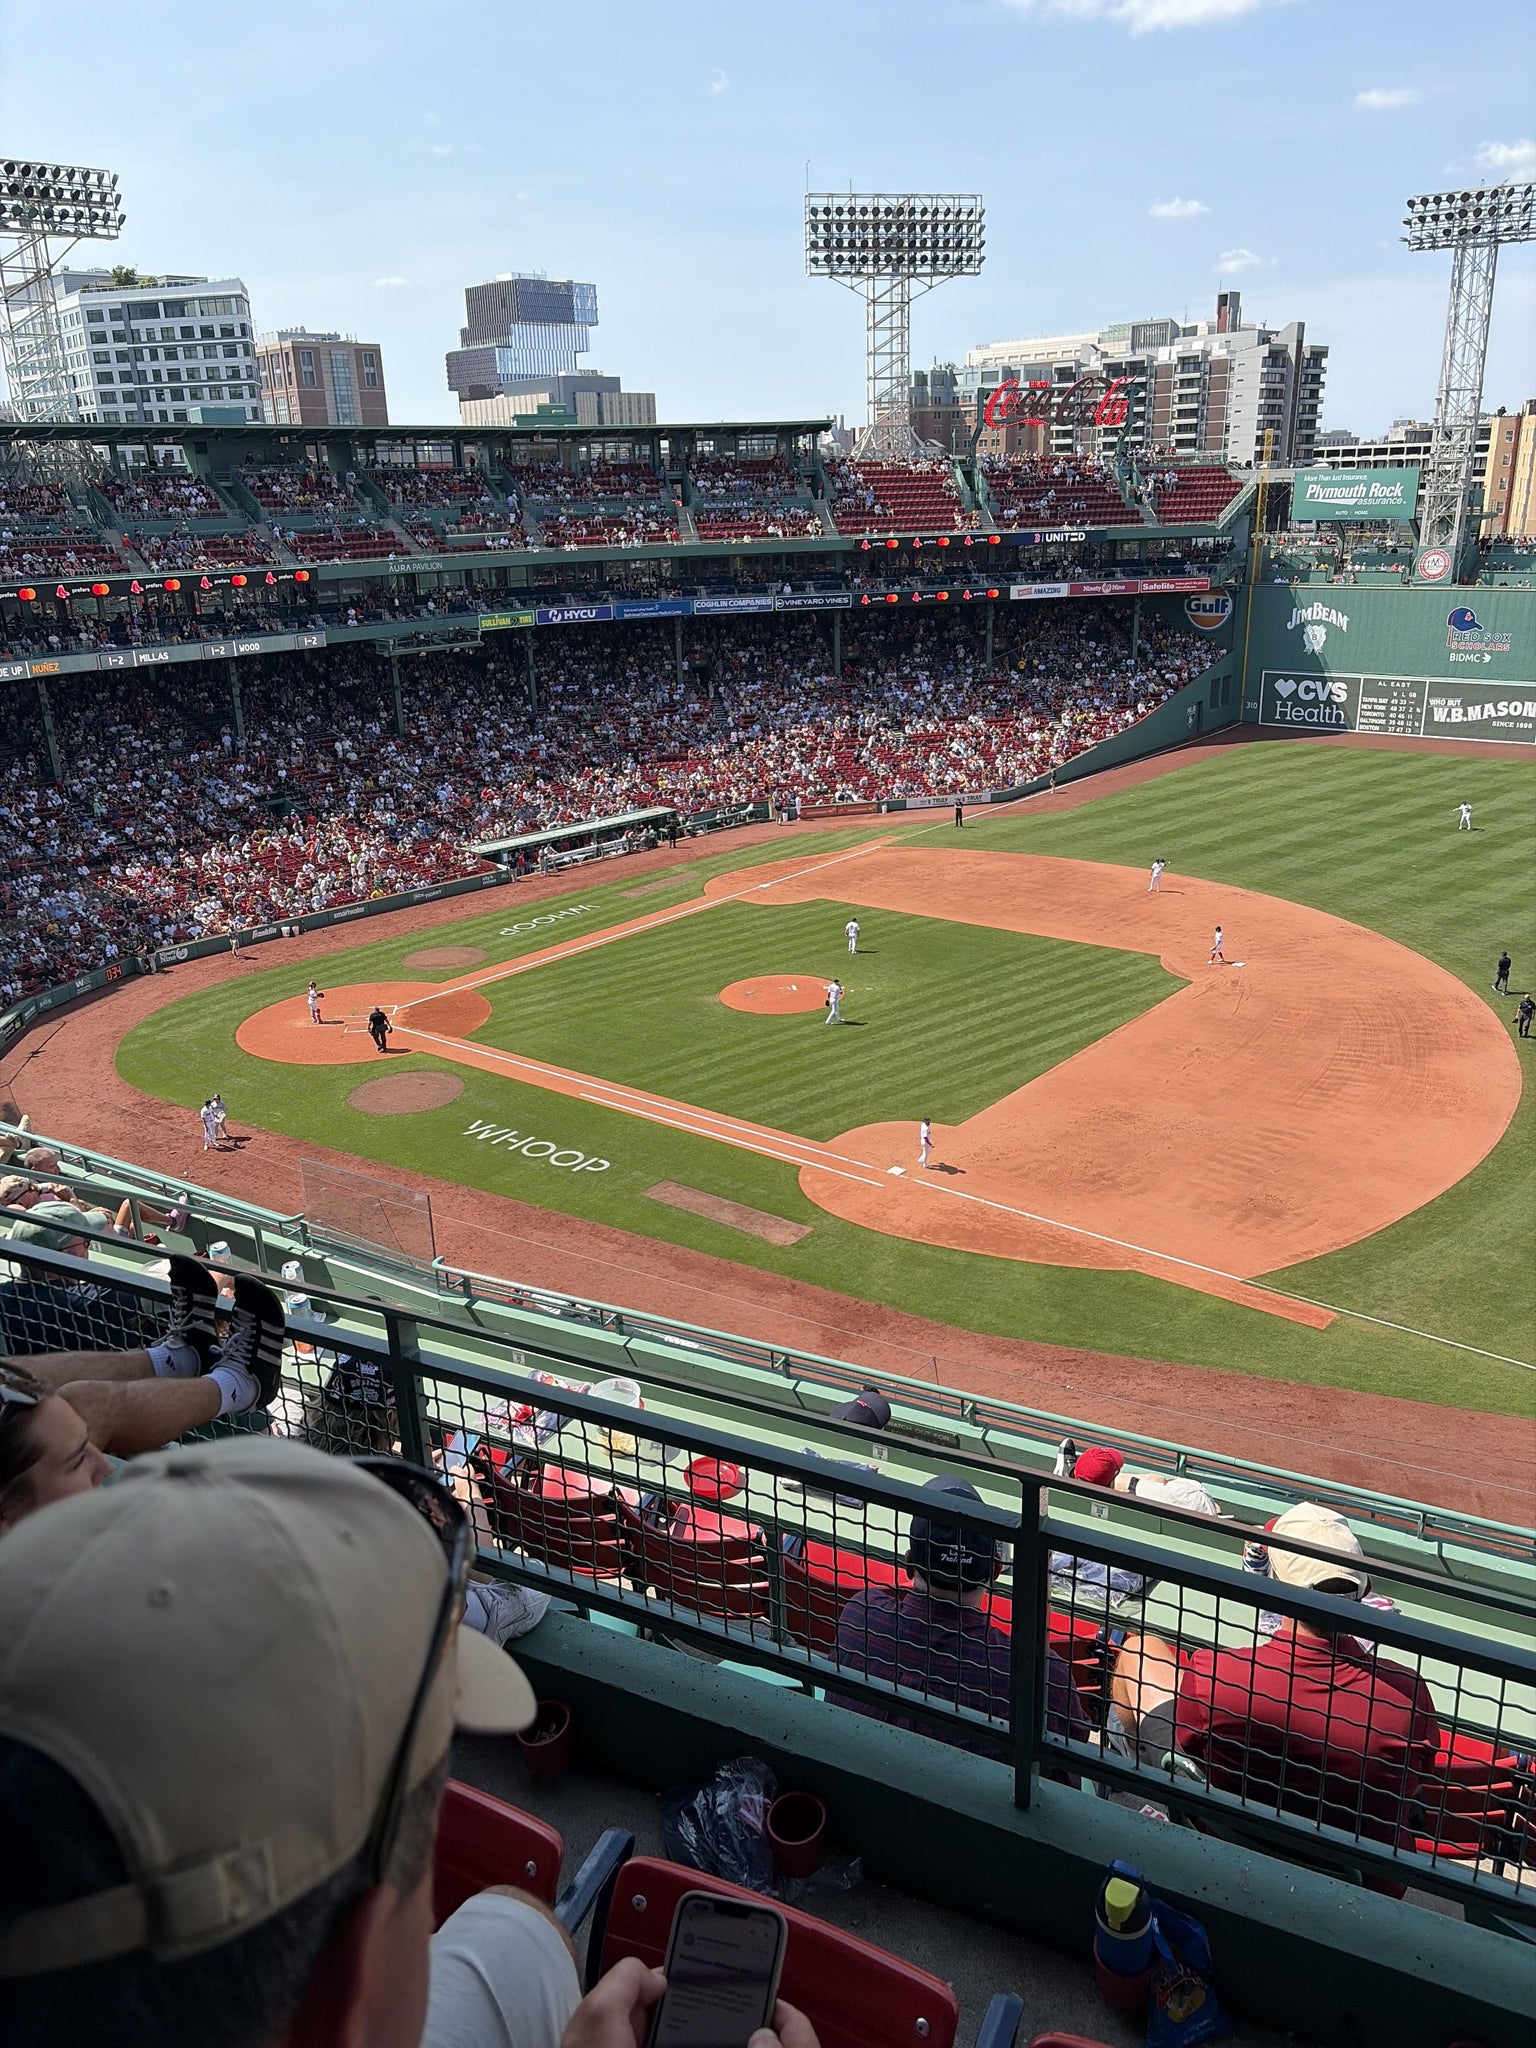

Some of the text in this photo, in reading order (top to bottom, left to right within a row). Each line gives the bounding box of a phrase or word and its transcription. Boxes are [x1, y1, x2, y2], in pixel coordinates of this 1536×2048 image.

[1306, 482, 1404, 499] Plymouth Rock
[1046, 532, 1086, 542] UNITED
[413, 562, 442, 571] PAVILION
[1142, 582, 1175, 590] Safelite
[1186, 597, 1229, 614] Gulf
[564, 610, 596, 620] HYCU
[482, 616, 510, 627] SULLIVAN
[304, 636, 317, 645] 1-2
[1453, 632, 1512, 642] RED SOX
[211, 647, 225, 656] 1-2
[239, 643, 260, 652] WOOD
[1451, 642, 1510, 651] SCHOLARS
[109, 655, 124, 666] 1-2
[139, 652, 169, 662] MILLAS
[1450, 653, 1480, 662] BIDMC
[11, 666, 23, 676] UP
[32, 662, 59, 673] NUÑEZ
[1298, 680, 1348, 702] CVS
[1274, 701, 1345, 724] Health
[425, 890, 442, 899] TICKET
[334, 906, 365, 918] smartwater
[500, 904, 601, 936] WHOOP
[252, 927, 276, 939] Franklin
[462, 1120, 610, 1172] WHOOP
[888, 1421, 912, 1431] WATCH
[934, 1432, 950, 1441] FOR
